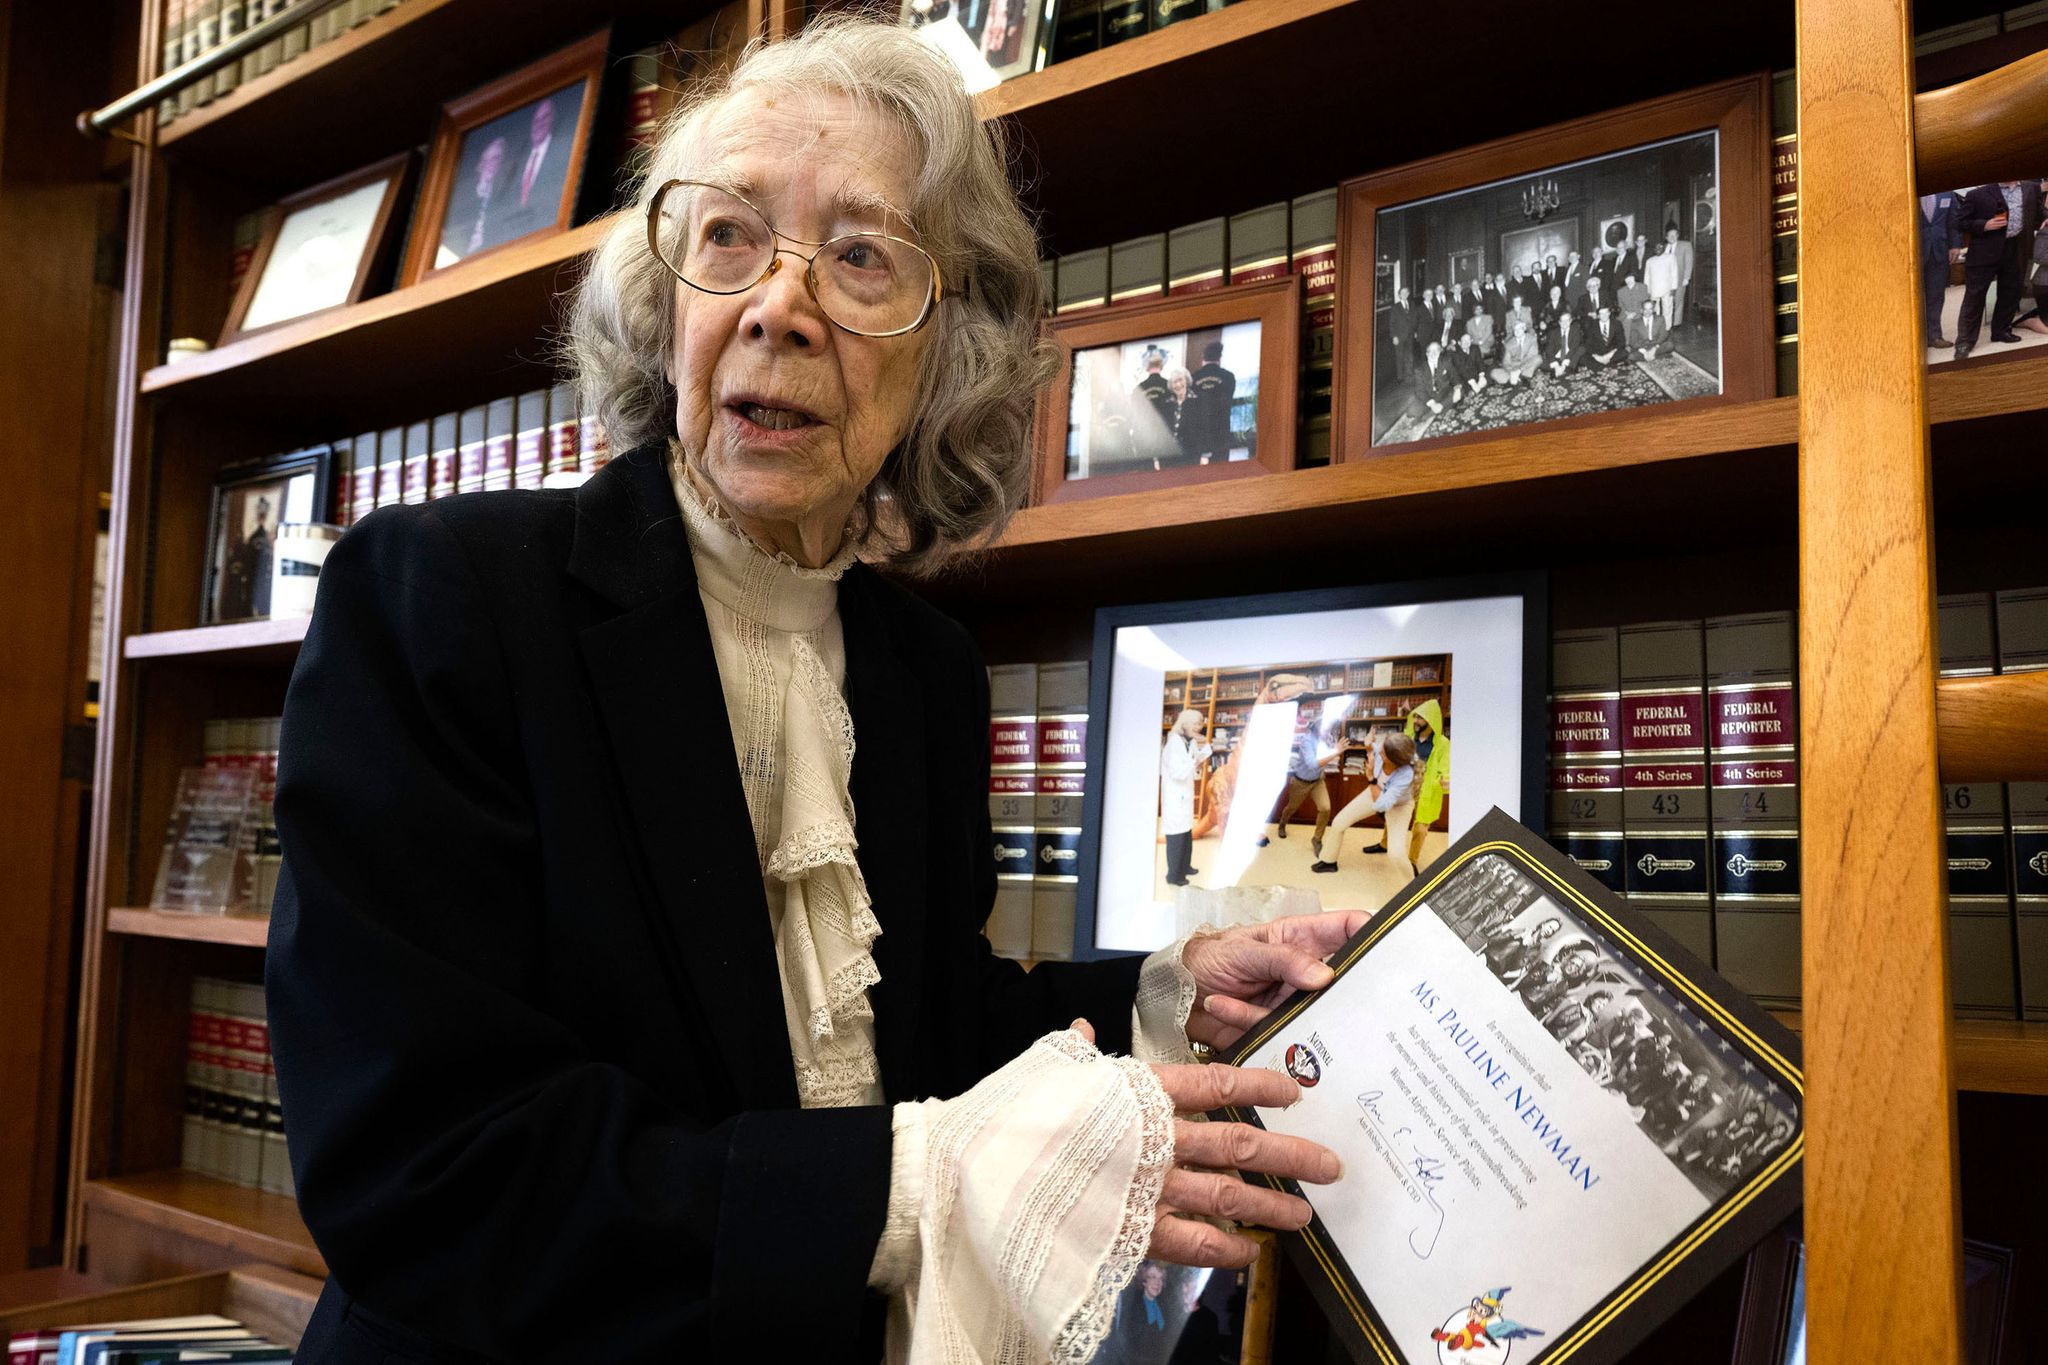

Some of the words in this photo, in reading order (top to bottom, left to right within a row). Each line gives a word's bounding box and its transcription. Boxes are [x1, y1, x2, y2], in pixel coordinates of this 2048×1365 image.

[1636, 706, 1687, 720] FEDERAL
[1723, 701, 1777, 717] FEDERAL
[1558, 711, 1606, 724] FEDERAL
[1555, 728, 1610, 742] REPORTER
[1633, 724, 1692, 738] REPORTER
[1720, 720, 1782, 735] REPORTER
[1556, 774, 1573, 784] 4th
[1577, 774, 1610, 784] Series
[1634, 771, 1653, 782] 4th
[1657, 771, 1693, 782] Series
[1723, 769, 1742, 780] 4th
[1746, 768, 1783, 779] Series
[1652, 794, 1680, 815] 43
[1494, 1030, 1536, 1075] recognition
[1532, 1073, 1552, 1093] that
[1407, 1024, 1421, 1040] has
[1414, 1038, 1443, 1064] played
[1436, 1062, 1449, 1075] an
[1445, 1073, 1479, 1109] essential
[1473, 1107, 1491, 1125] role
[1487, 1123, 1499, 1137] in
[1493, 1135, 1537, 1184] preserving
[1437, 1008, 1510, 1089] PAULINE
[1505, 1086, 1599, 1190] NEWMAN
[1390, 1066, 1412, 1097] Women
[1433, 1126, 1461, 1159] Service
[1385, 1031, 1398, 1044] the
[1394, 1042, 1420, 1072] memory
[1416, 1071, 1435, 1088] and
[1428, 1084, 1454, 1114] history
[1449, 1112, 1465, 1128] of
[1458, 1122, 1473, 1139] the
[1467, 1139, 1528, 1210] groundbreaking
[1406, 1185, 1421, 1203] CEO
